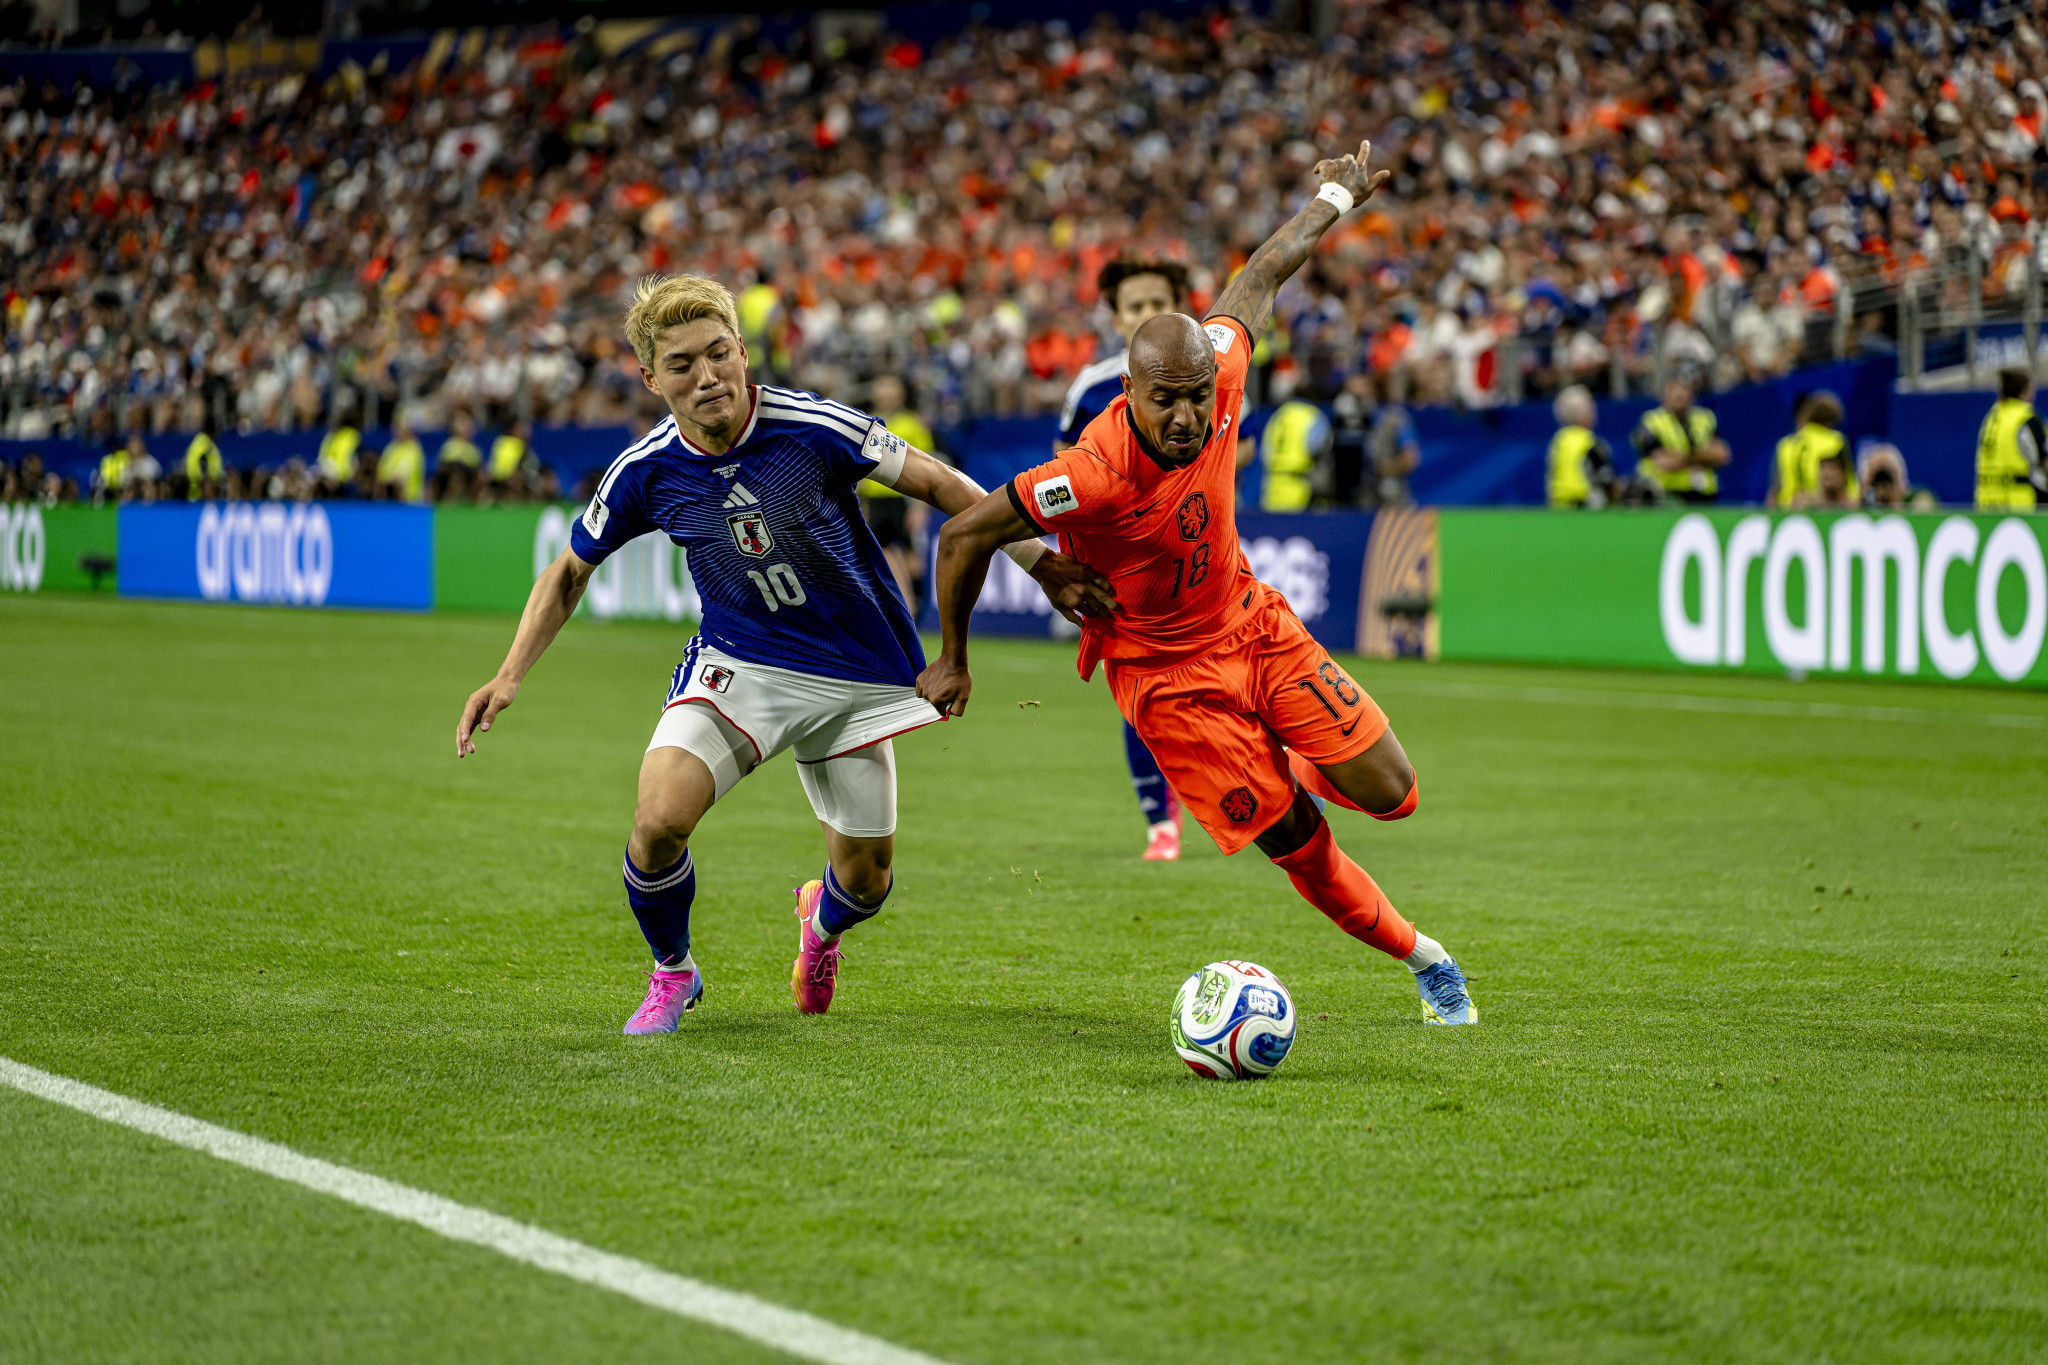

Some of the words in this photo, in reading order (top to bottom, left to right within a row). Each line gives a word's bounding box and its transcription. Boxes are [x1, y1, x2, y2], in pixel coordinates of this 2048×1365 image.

[747, 563, 807, 612] 10
[1169, 541, 1211, 599] 18
[1659, 512, 2047, 682] aramco
[1298, 661, 1361, 722] 18
